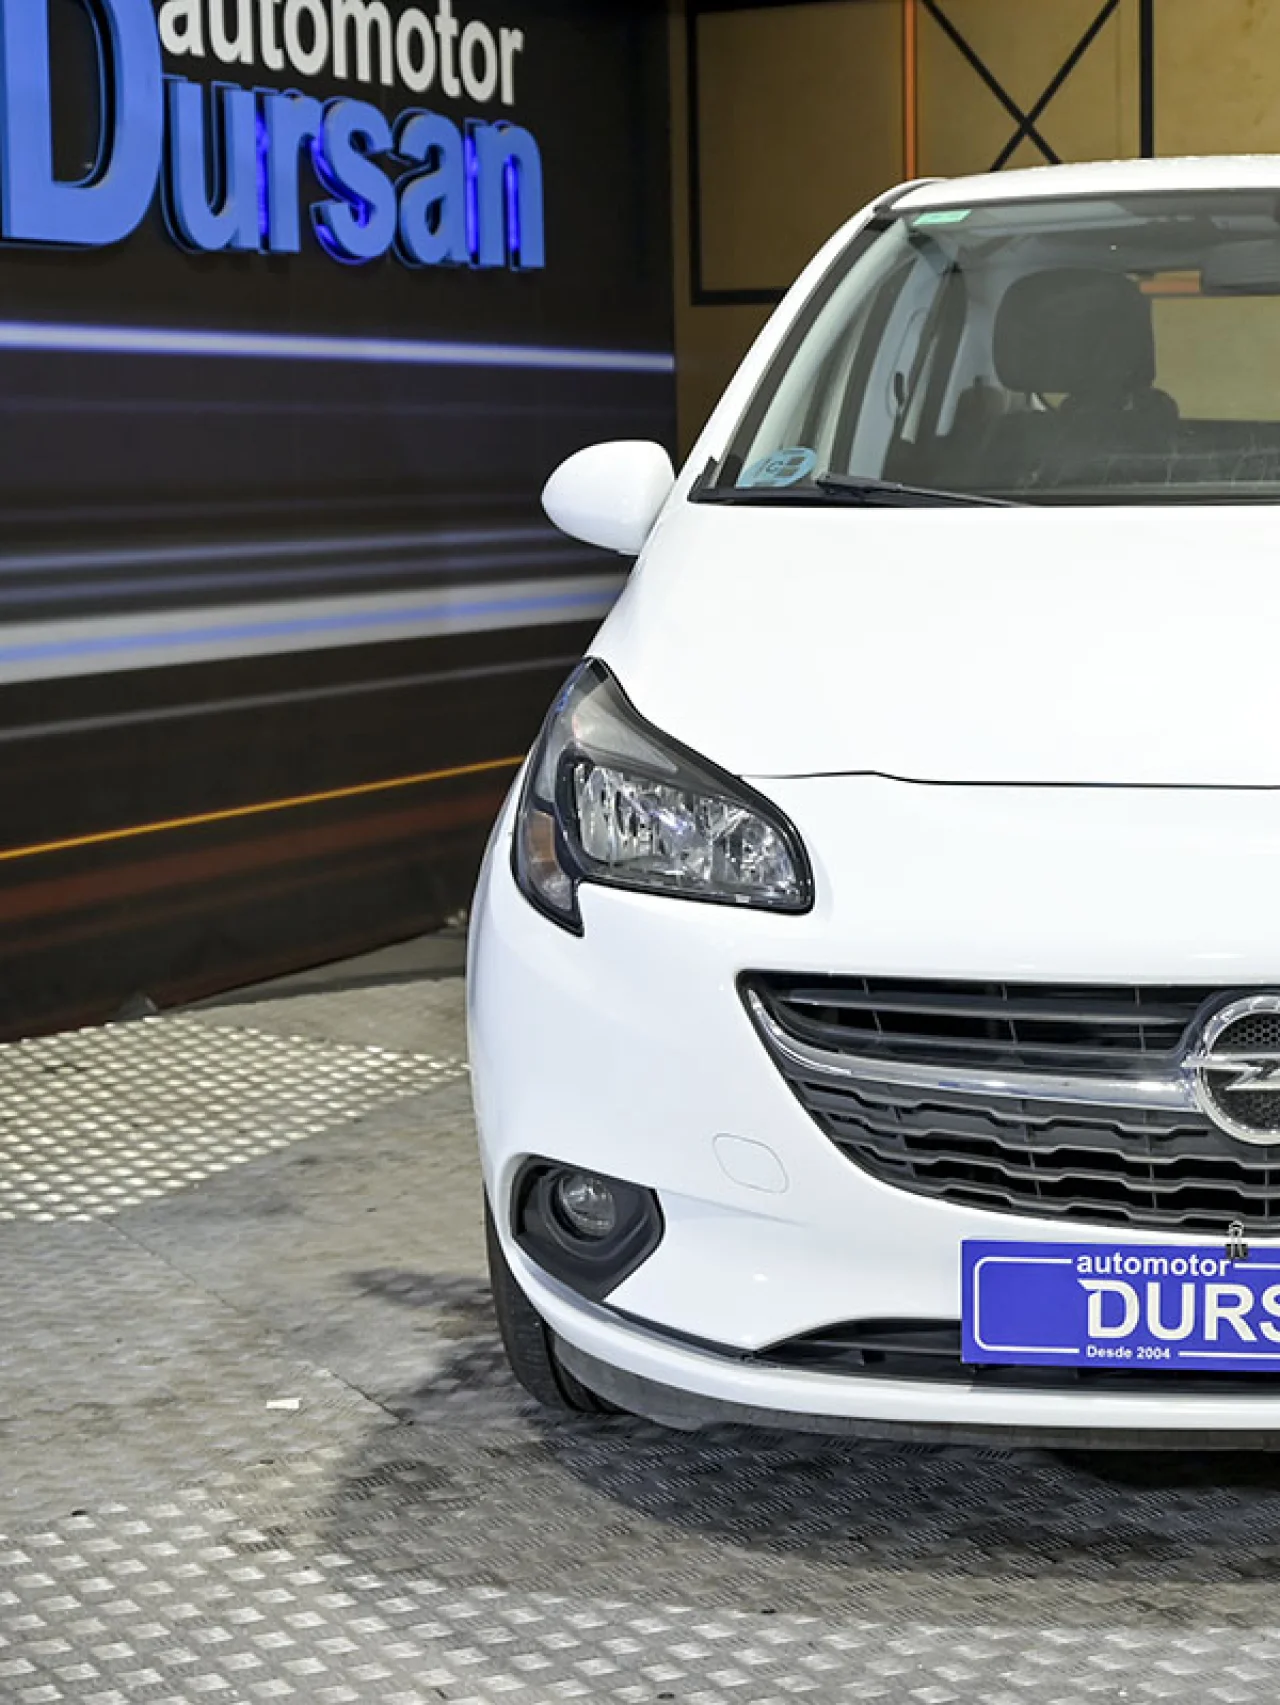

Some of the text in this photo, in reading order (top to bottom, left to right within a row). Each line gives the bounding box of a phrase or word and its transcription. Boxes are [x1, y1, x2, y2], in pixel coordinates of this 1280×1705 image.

[158, 0, 524, 105] automotor
[0, 0, 546, 269] Dursan
[1077, 1252, 1230, 1277] automotor
[1086, 1344, 1171, 1359] Desde 2004
